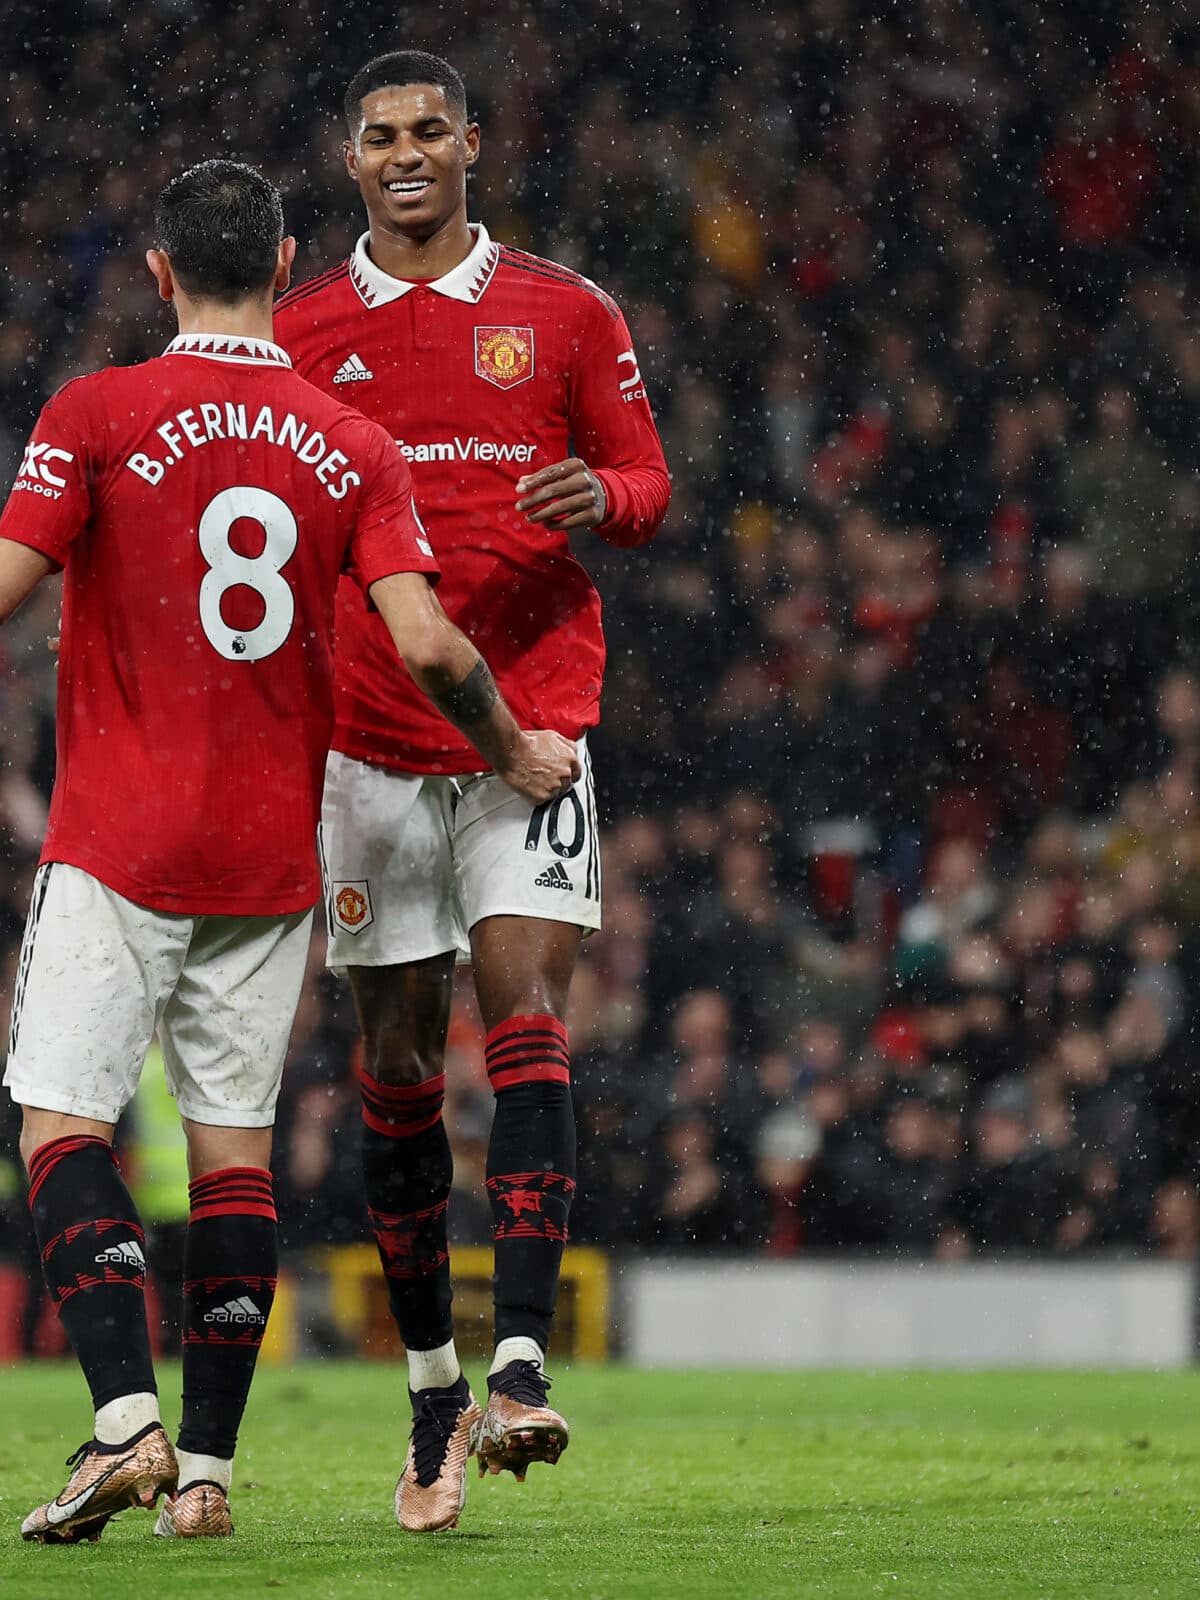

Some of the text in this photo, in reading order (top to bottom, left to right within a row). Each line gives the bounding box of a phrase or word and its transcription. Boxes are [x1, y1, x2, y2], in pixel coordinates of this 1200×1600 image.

[333, 370, 373, 384] adidas
[126, 402, 361, 501] B.FERNANDES
[395, 436, 537, 463] eamViewer
[18, 441, 74, 488] XC
[198, 485, 298, 661] 8
[524, 787, 585, 858] 10
[535, 876, 573, 891] adidas
[95, 1252, 146, 1277] adida
[204, 1310, 265, 1325] adidas
